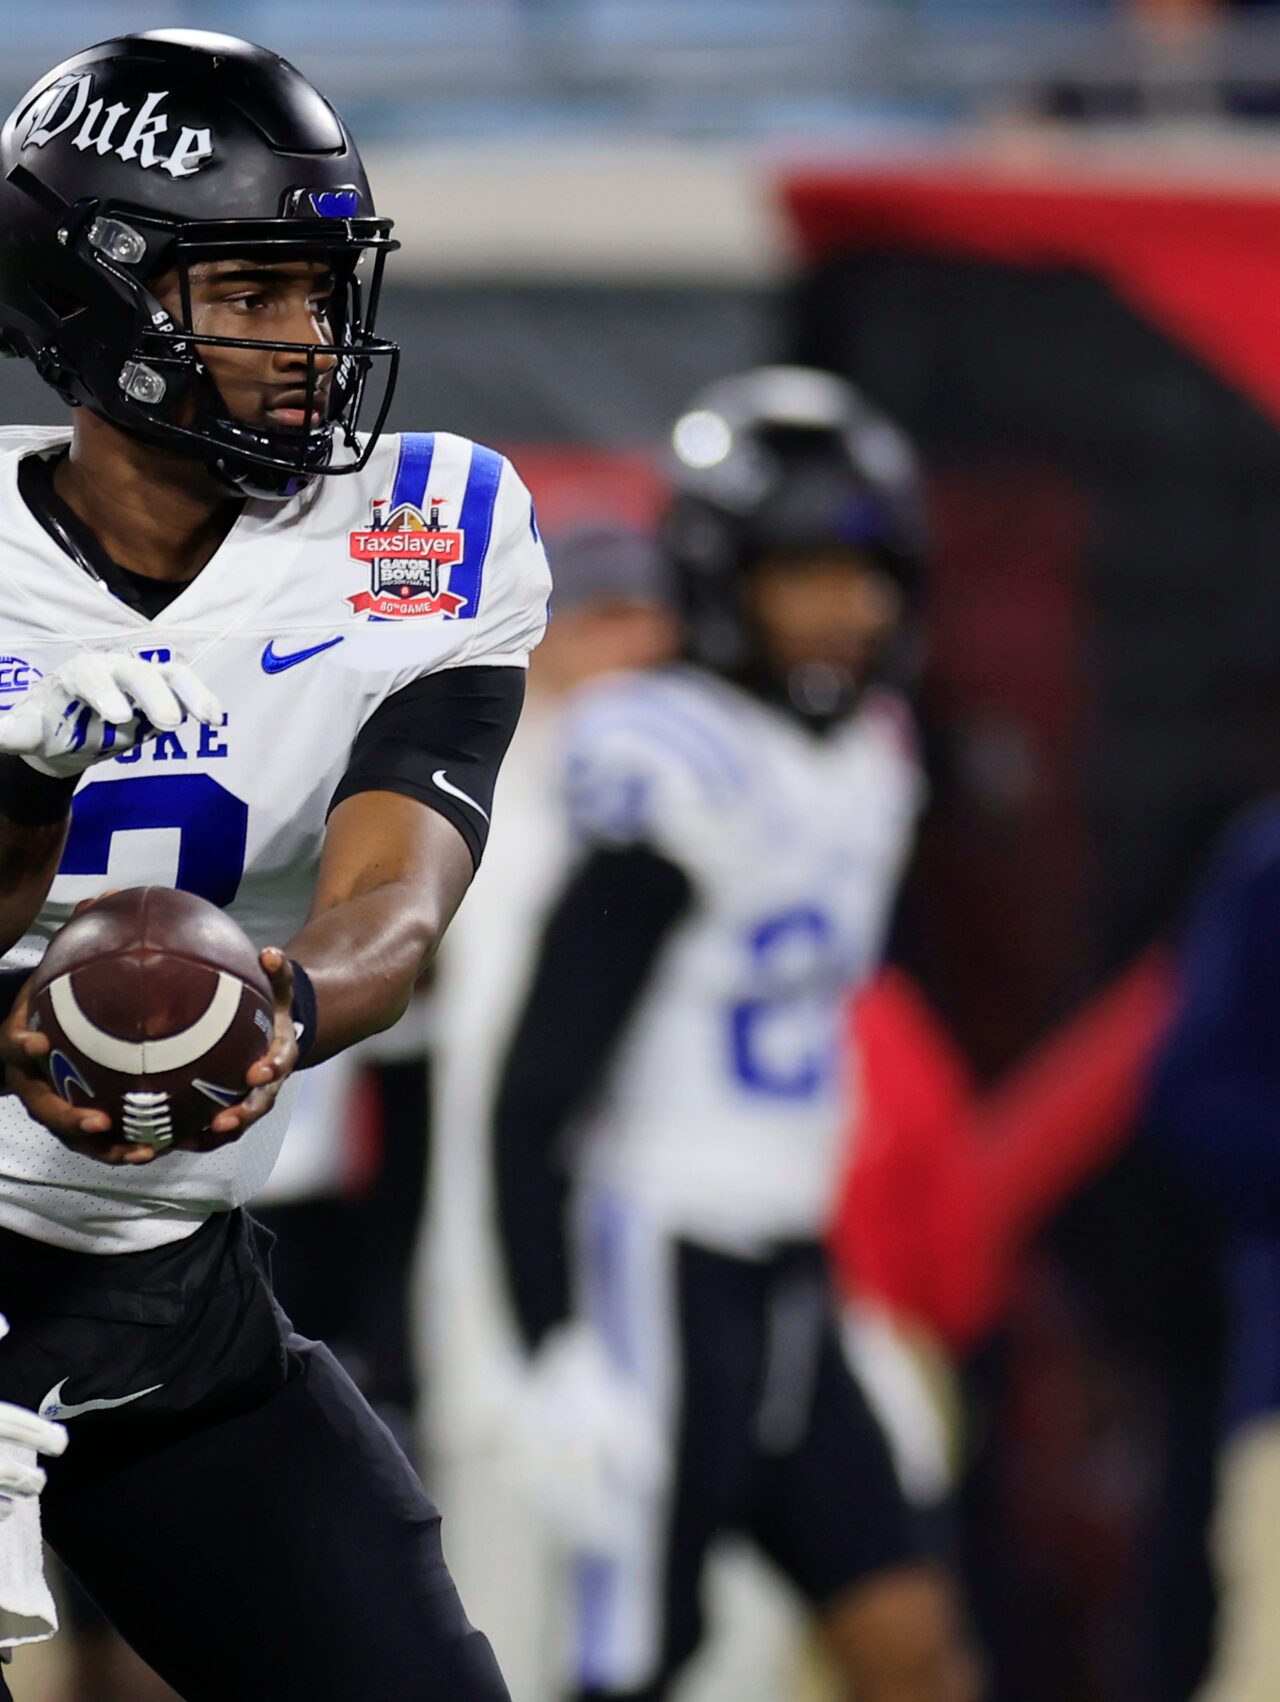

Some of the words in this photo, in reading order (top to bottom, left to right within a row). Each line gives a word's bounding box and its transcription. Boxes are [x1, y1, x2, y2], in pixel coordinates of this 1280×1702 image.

[15, 73, 213, 178] Duke
[355, 535, 455, 555] TaxSlayer
[380, 558, 430, 570] GATOR
[380, 569, 430, 581] BOWL
[400, 602, 432, 614] GAME
[114, 712, 228, 764] KE
